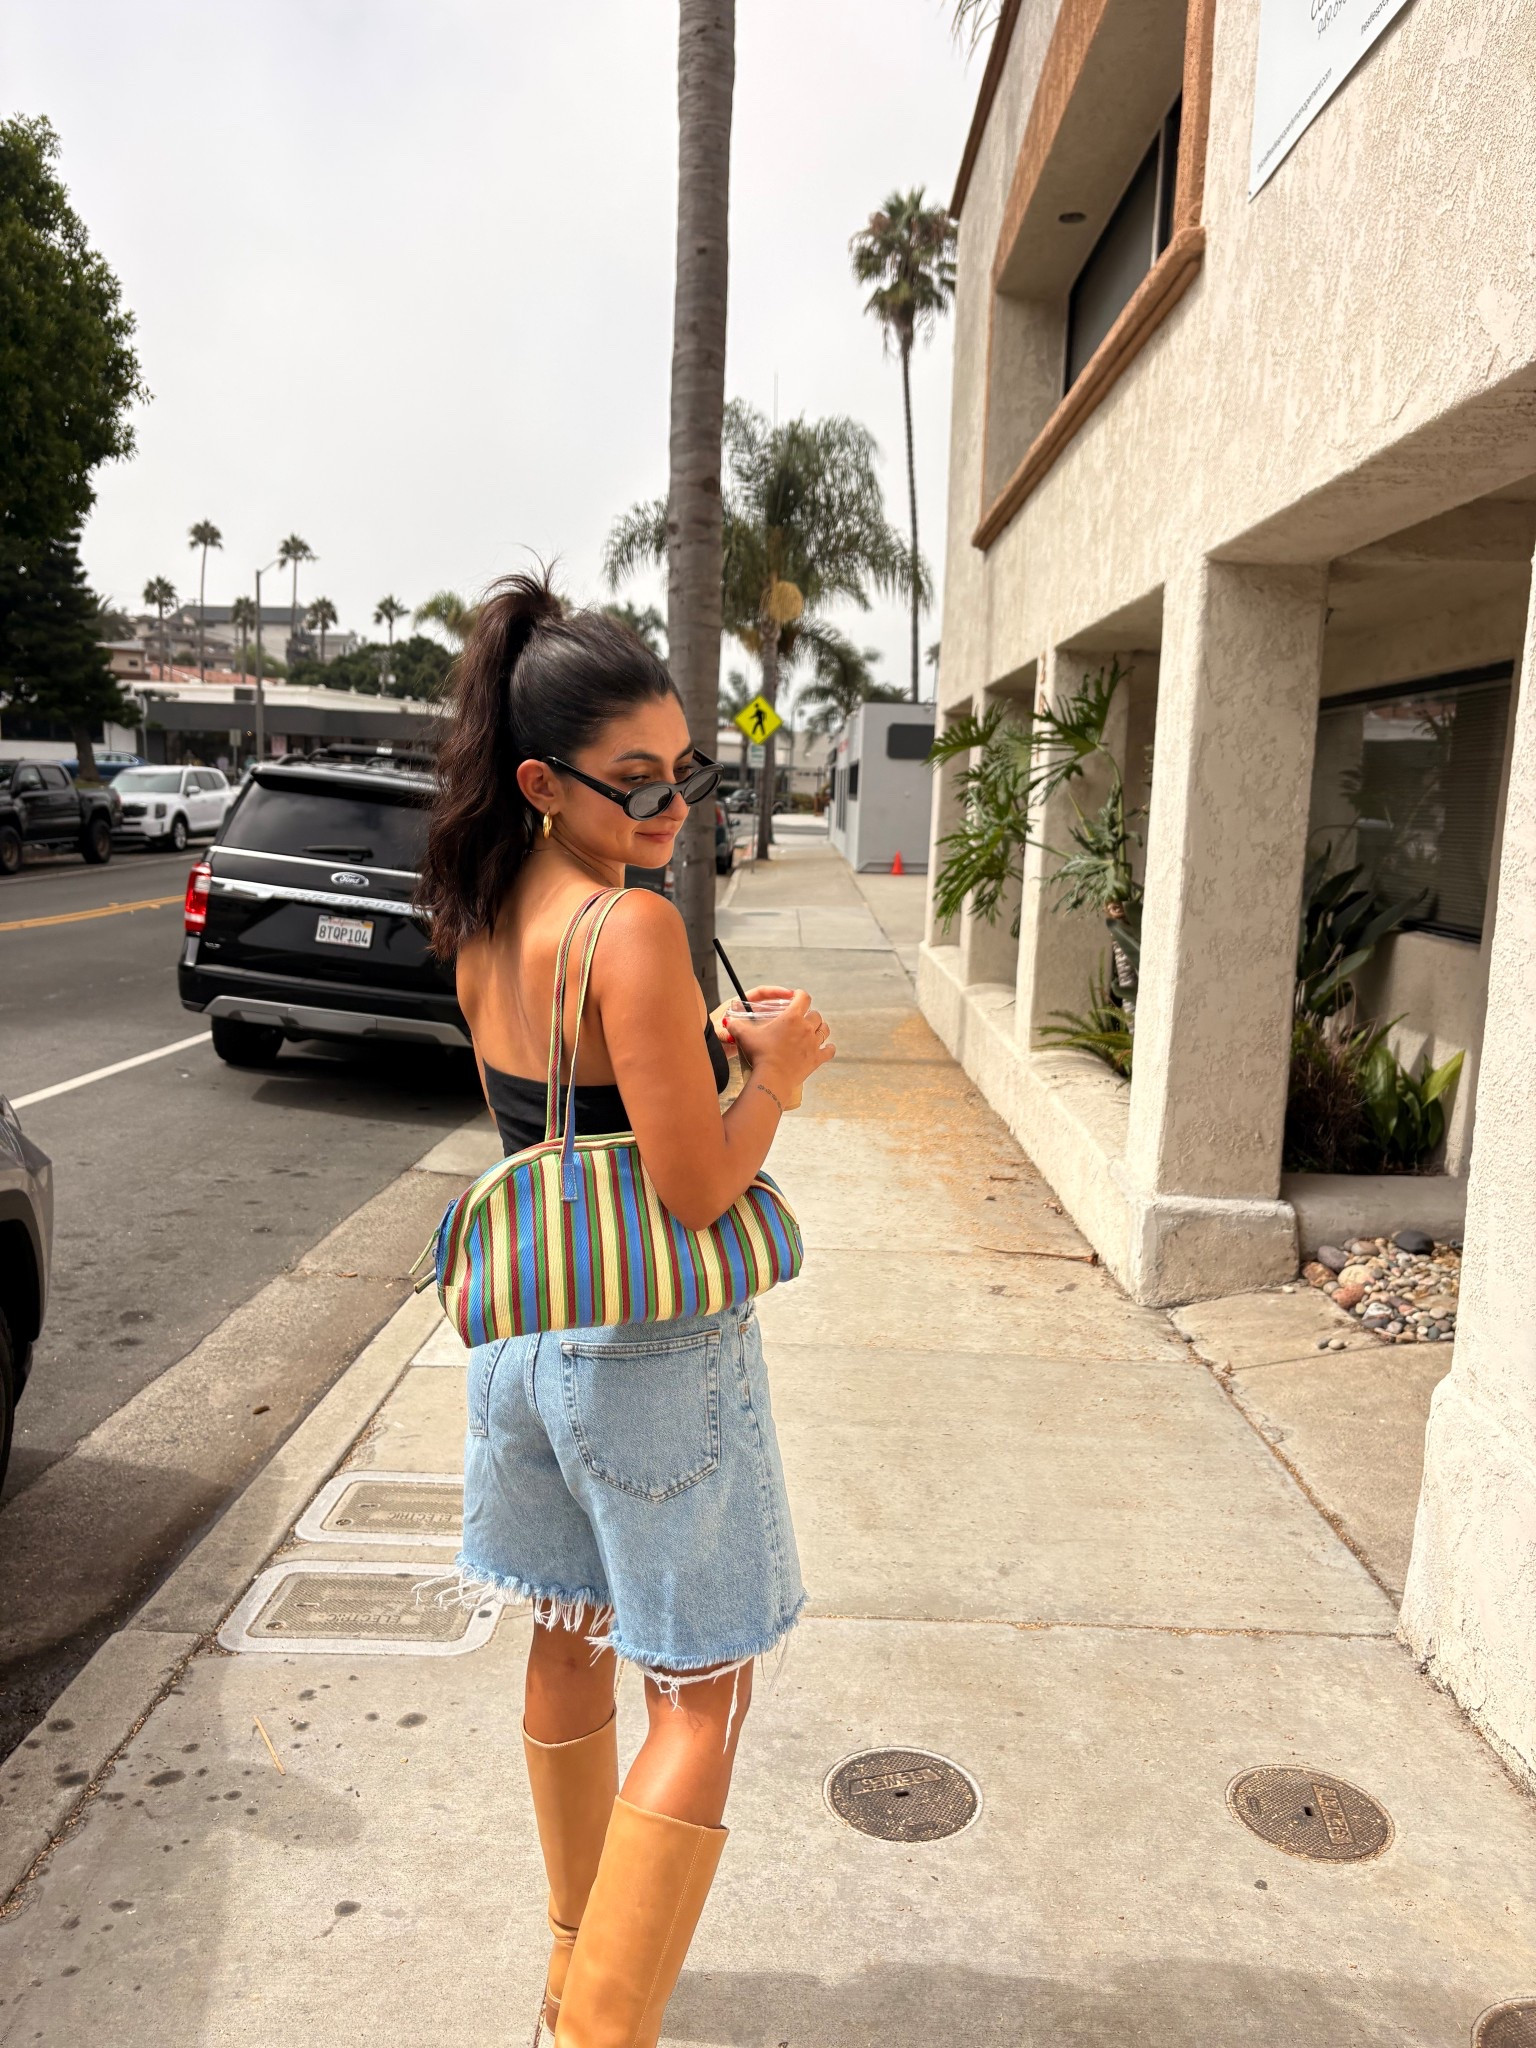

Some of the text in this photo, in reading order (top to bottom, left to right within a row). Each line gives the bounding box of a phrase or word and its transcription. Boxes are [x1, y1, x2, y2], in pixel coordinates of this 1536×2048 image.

[318, 924, 368, 945] 8TQP104
[387, 1511, 453, 1522] ELECTRIC
[326, 1612, 401, 1624] ELECTRIC
